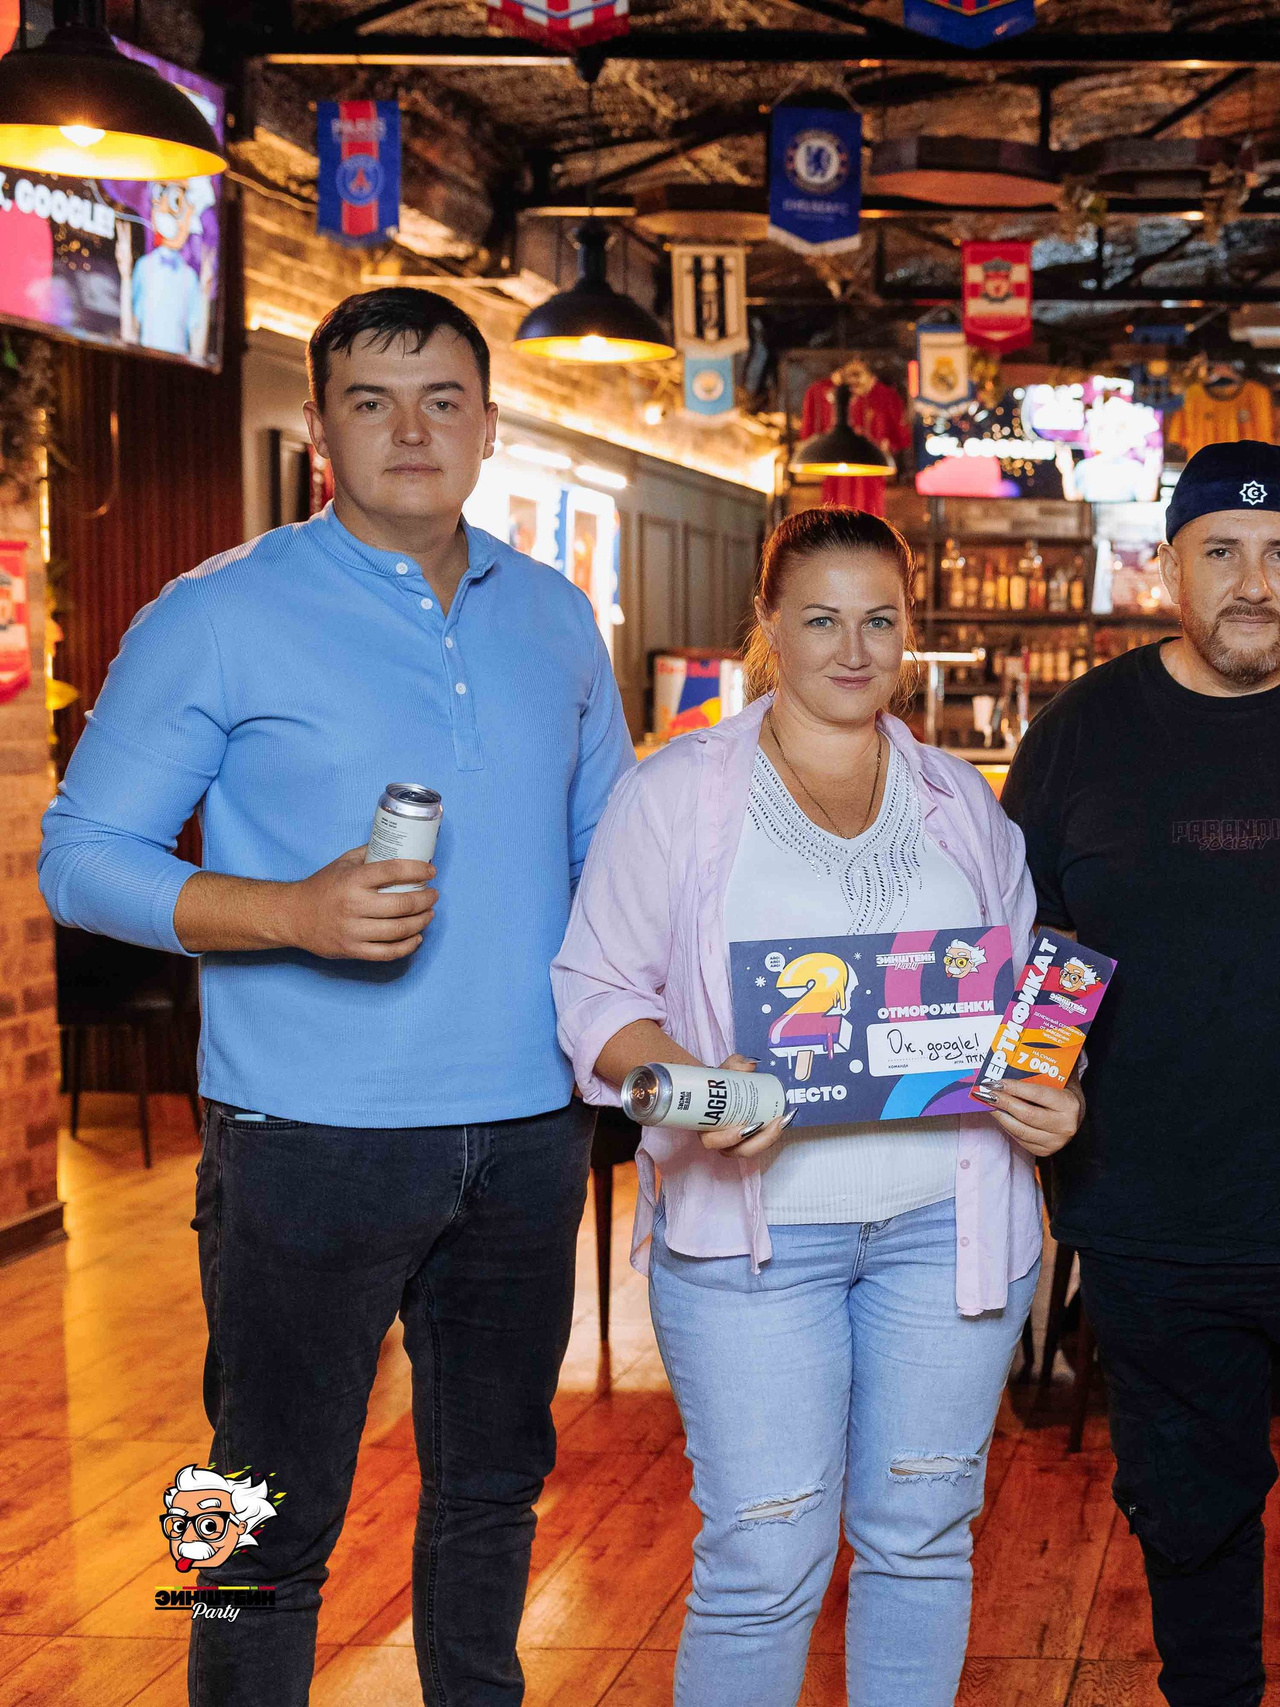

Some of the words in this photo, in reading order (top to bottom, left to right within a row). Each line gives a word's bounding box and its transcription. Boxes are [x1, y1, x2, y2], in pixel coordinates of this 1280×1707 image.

[767, 951, 859, 1058] 2
[877, 1000, 995, 1019] ОТМОРОЖЕНКИ
[1017, 1051, 1029, 1064] 7
[1029, 1057, 1060, 1078] 000
[677, 1091, 687, 1111] SIGMA
[698, 1079, 727, 1127] LAGER
